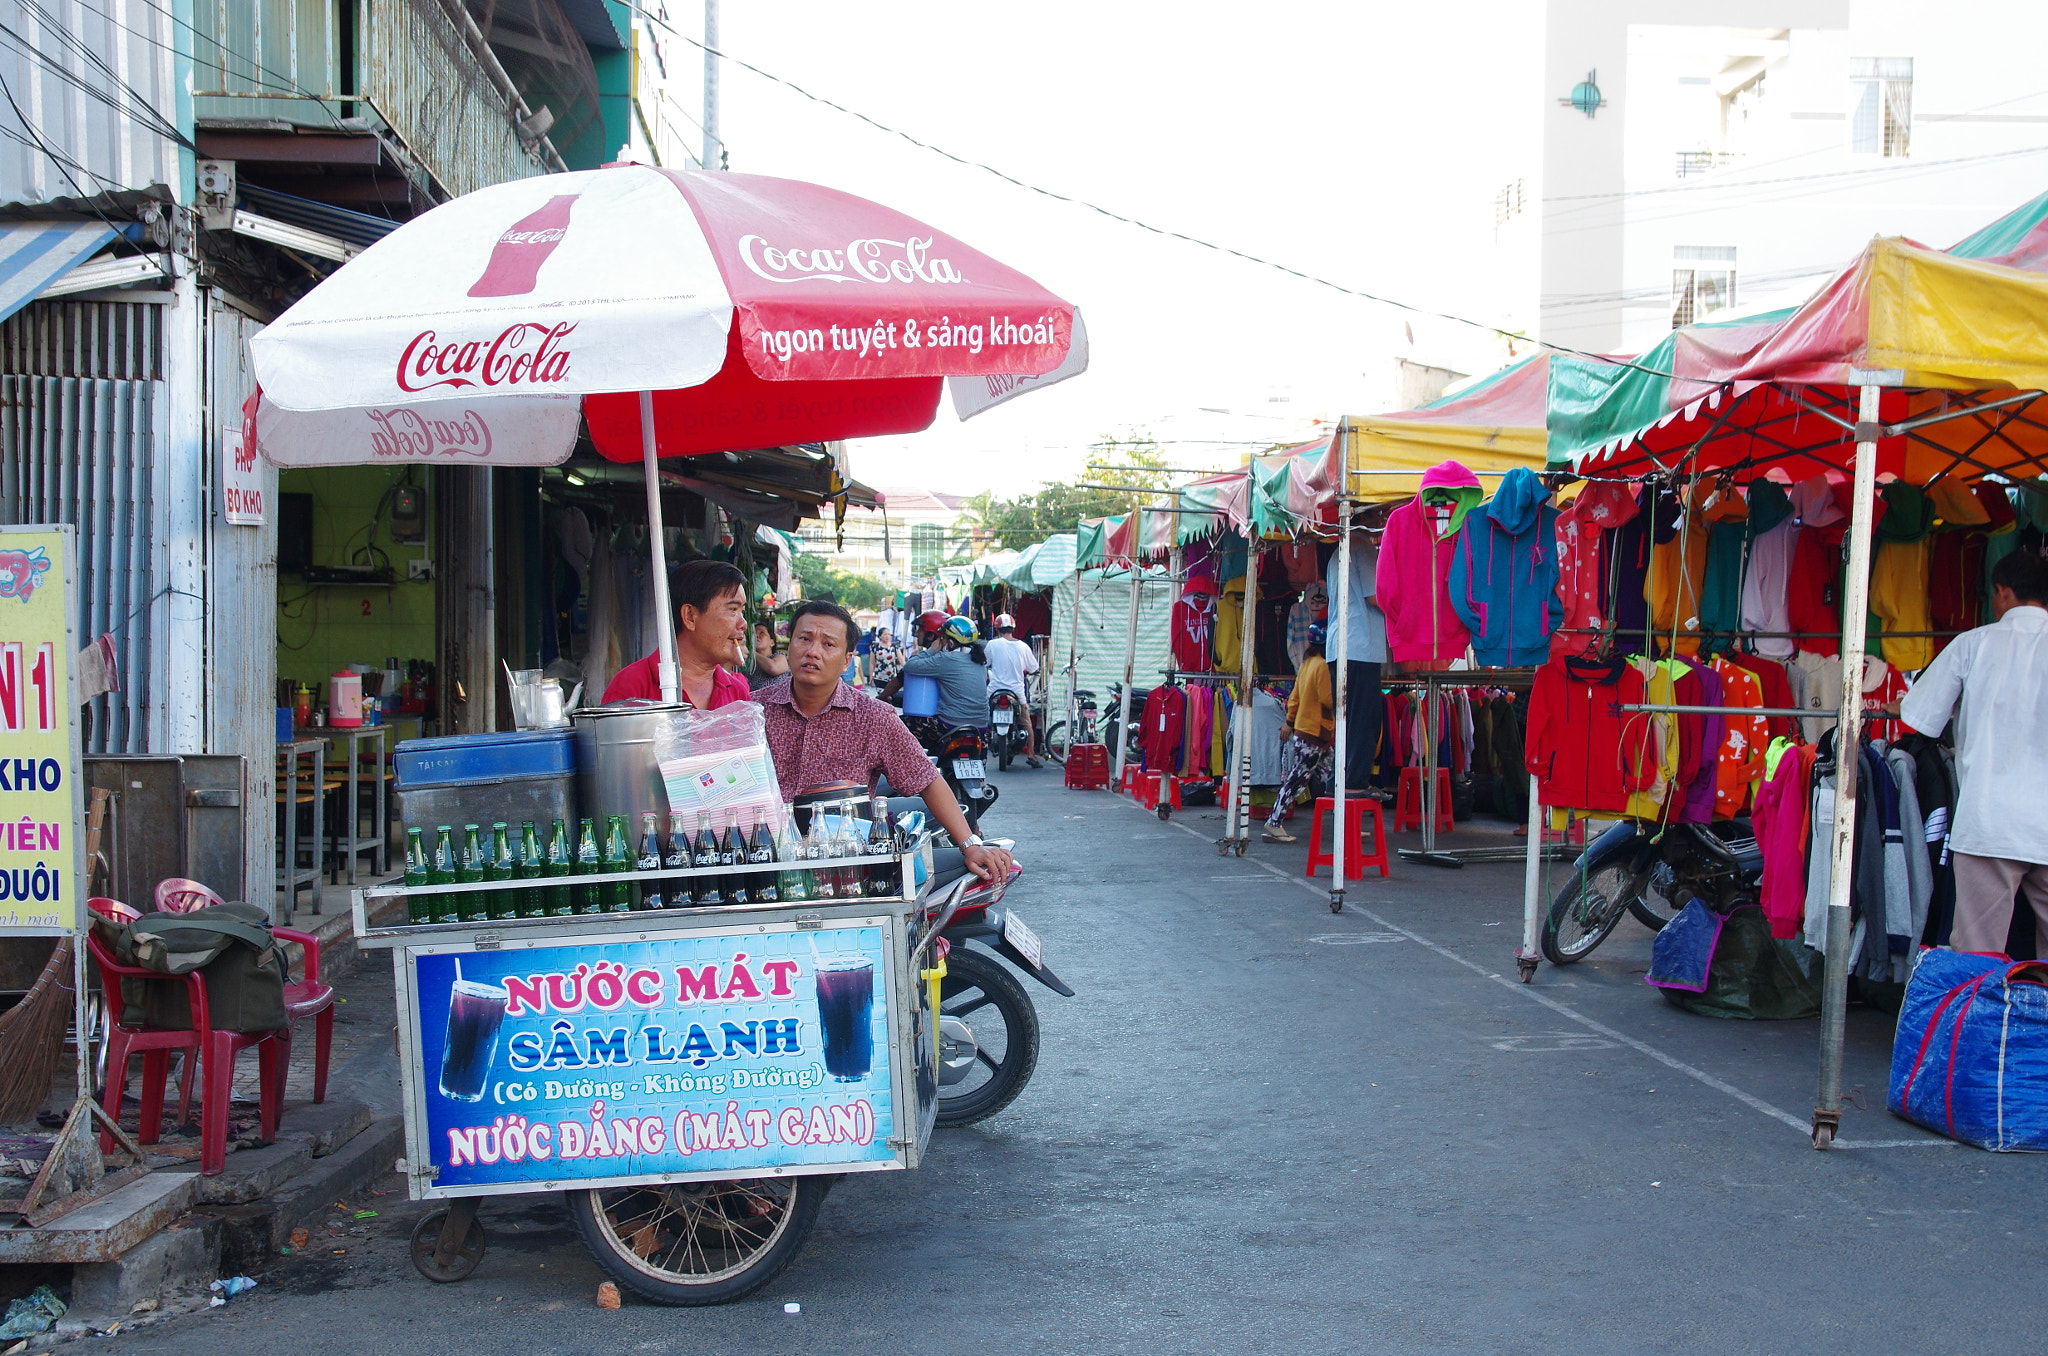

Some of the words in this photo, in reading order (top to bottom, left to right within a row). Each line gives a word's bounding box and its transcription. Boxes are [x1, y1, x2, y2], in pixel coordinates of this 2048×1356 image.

[738, 234, 962, 284] Coca-Cola
[396, 320, 580, 393] Coca-Cola
[761, 325, 824, 361] ngon
[830, 319, 897, 358] tuyệt
[903, 318, 921, 348] &
[927, 316, 983, 354] sảng
[990, 316, 1055, 346] khoái
[227, 480, 241, 513] BÒ
[243, 489, 262, 514] KHO
[361, 600, 372, 616] 2
[0, 758, 61, 793] KHO
[0, 861, 60, 902] ĐUÔI
[27, 911, 60, 926] mời
[502, 960, 664, 1017] NƯỚC
[675, 953, 803, 1005] MÁT
[509, 1018, 633, 1072] SÂM
[643, 1016, 806, 1070] LẠNH
[494, 1077, 538, 1105] (Có
[544, 1073, 626, 1102] Đường
[643, 1069, 727, 1096] Không
[731, 1063, 825, 1090] Đường)
[447, 1112, 553, 1167] NƯỚC
[558, 1100, 666, 1159] ĐẮNG
[674, 1100, 771, 1156] (MÁT
[778, 1099, 876, 1147] GAN)
